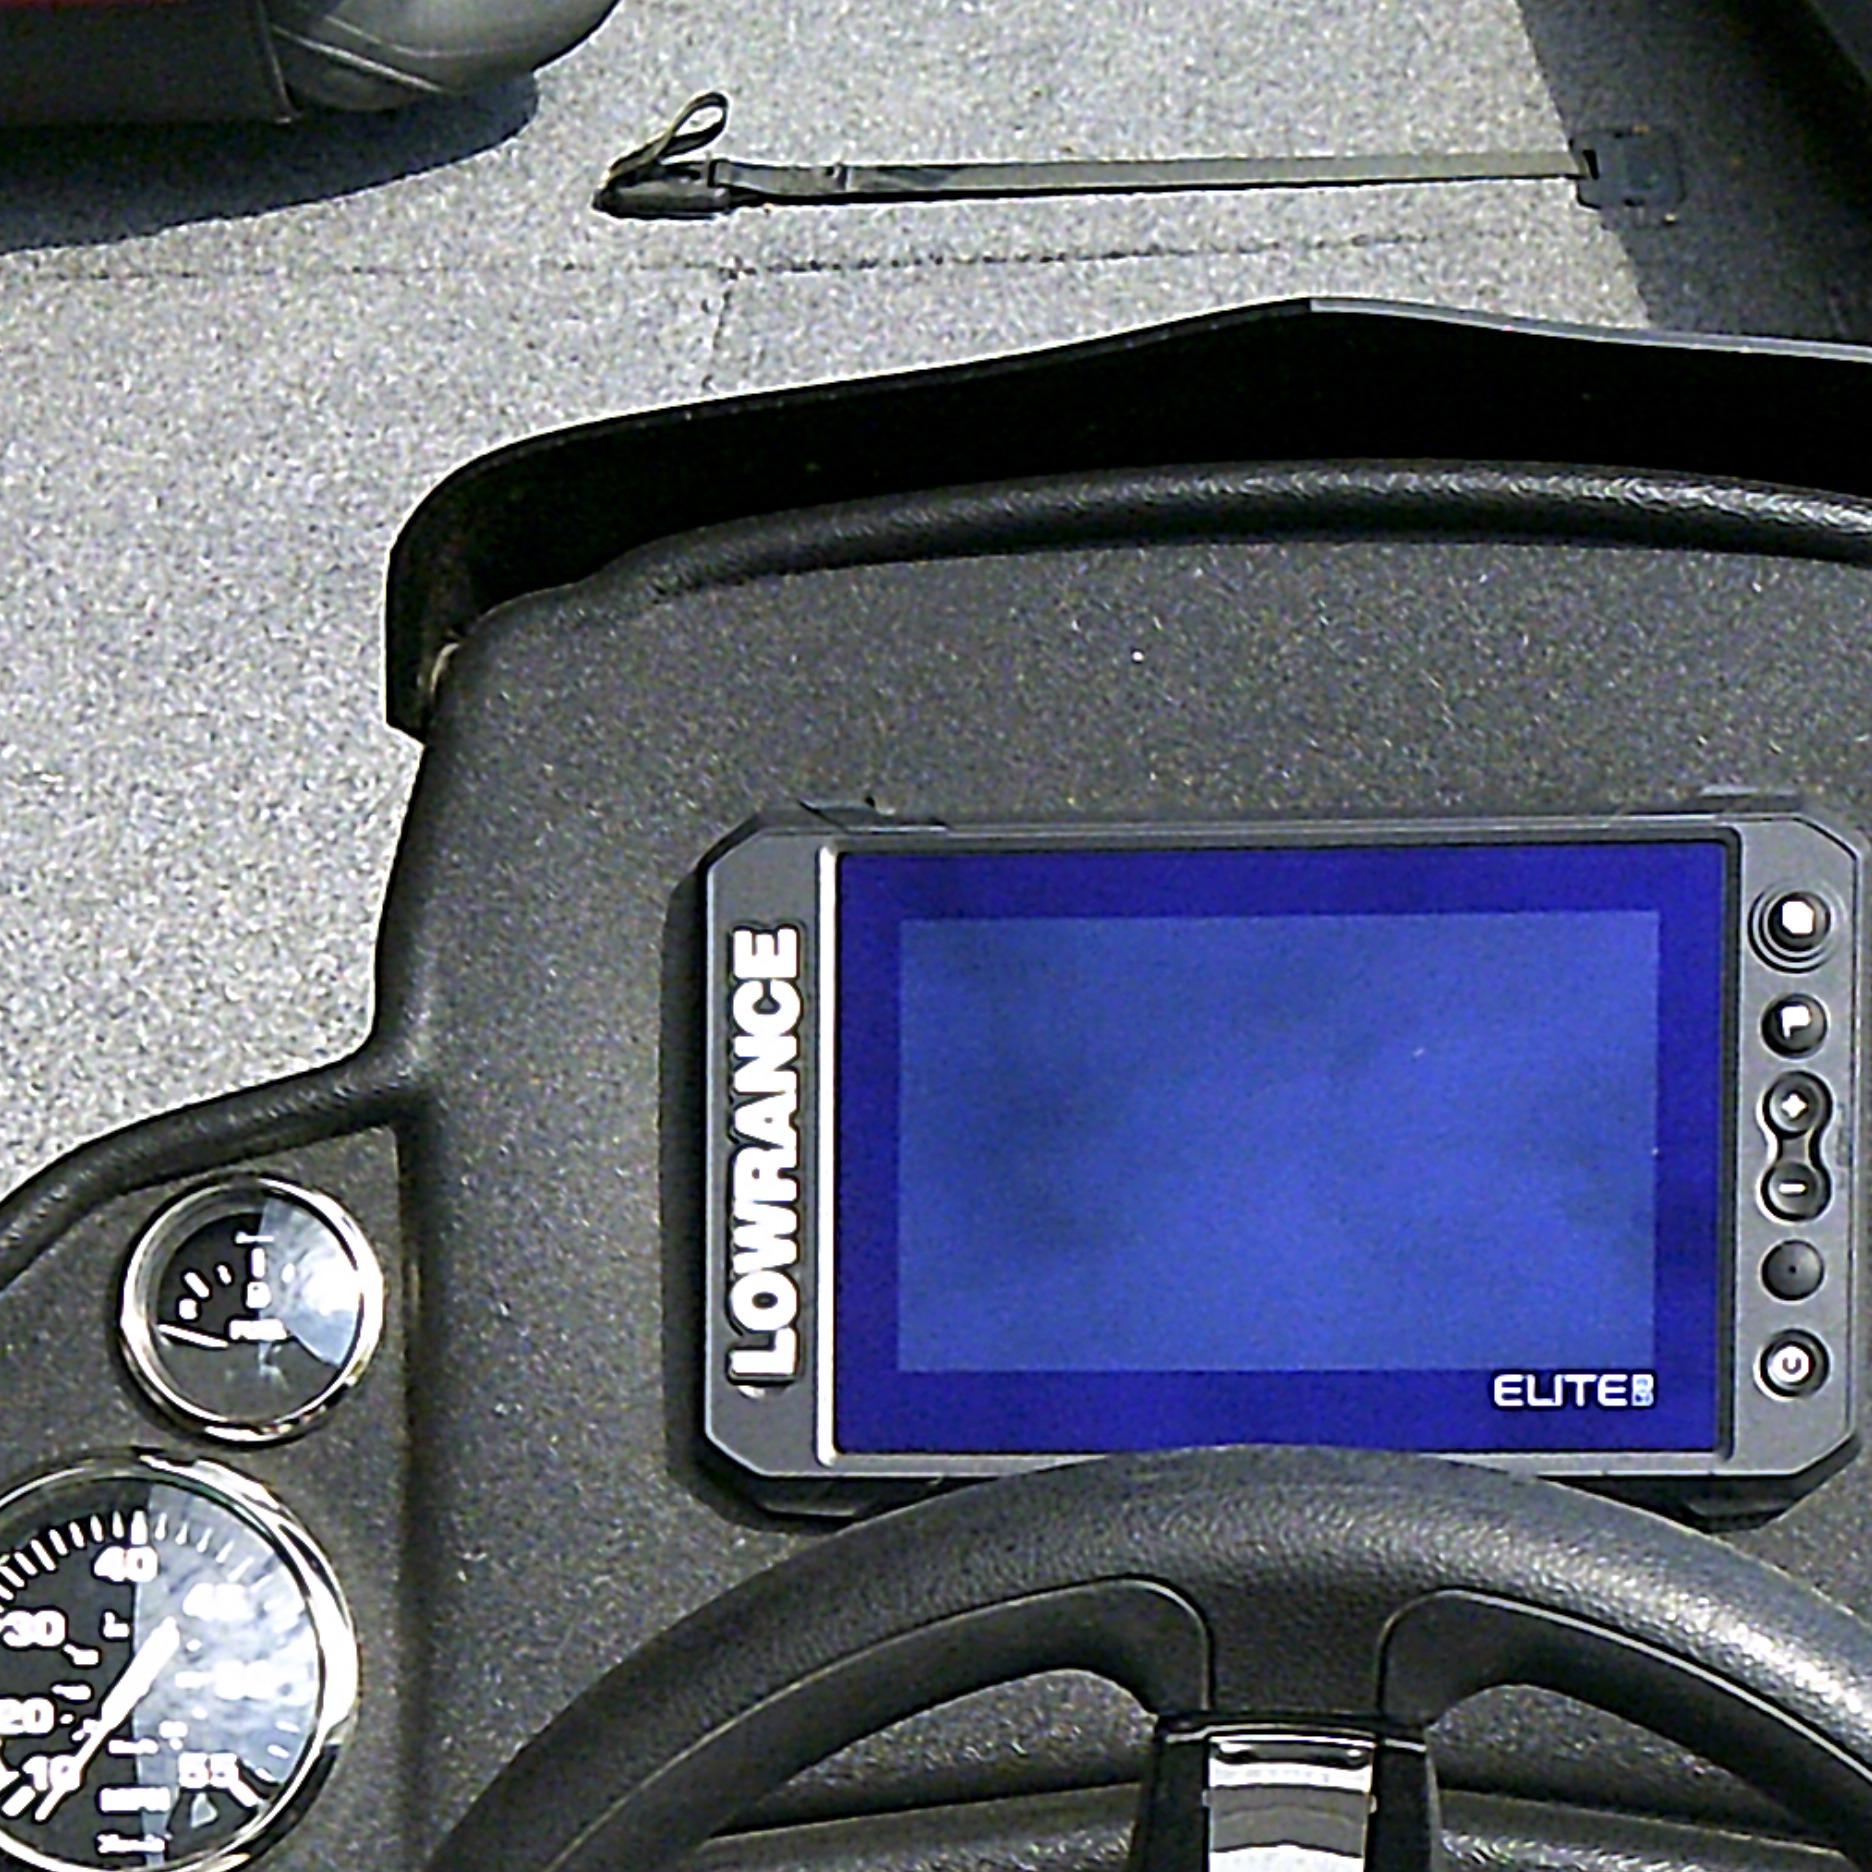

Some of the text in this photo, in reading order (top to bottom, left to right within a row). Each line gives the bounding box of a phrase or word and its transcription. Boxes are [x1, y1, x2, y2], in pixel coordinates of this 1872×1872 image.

[731, 926, 804, 1379] LOWRANCE
[94, 1545, 158, 1583] 40
[2, 1610, 66, 1648] 30
[21, 1755, 83, 1792] 10
